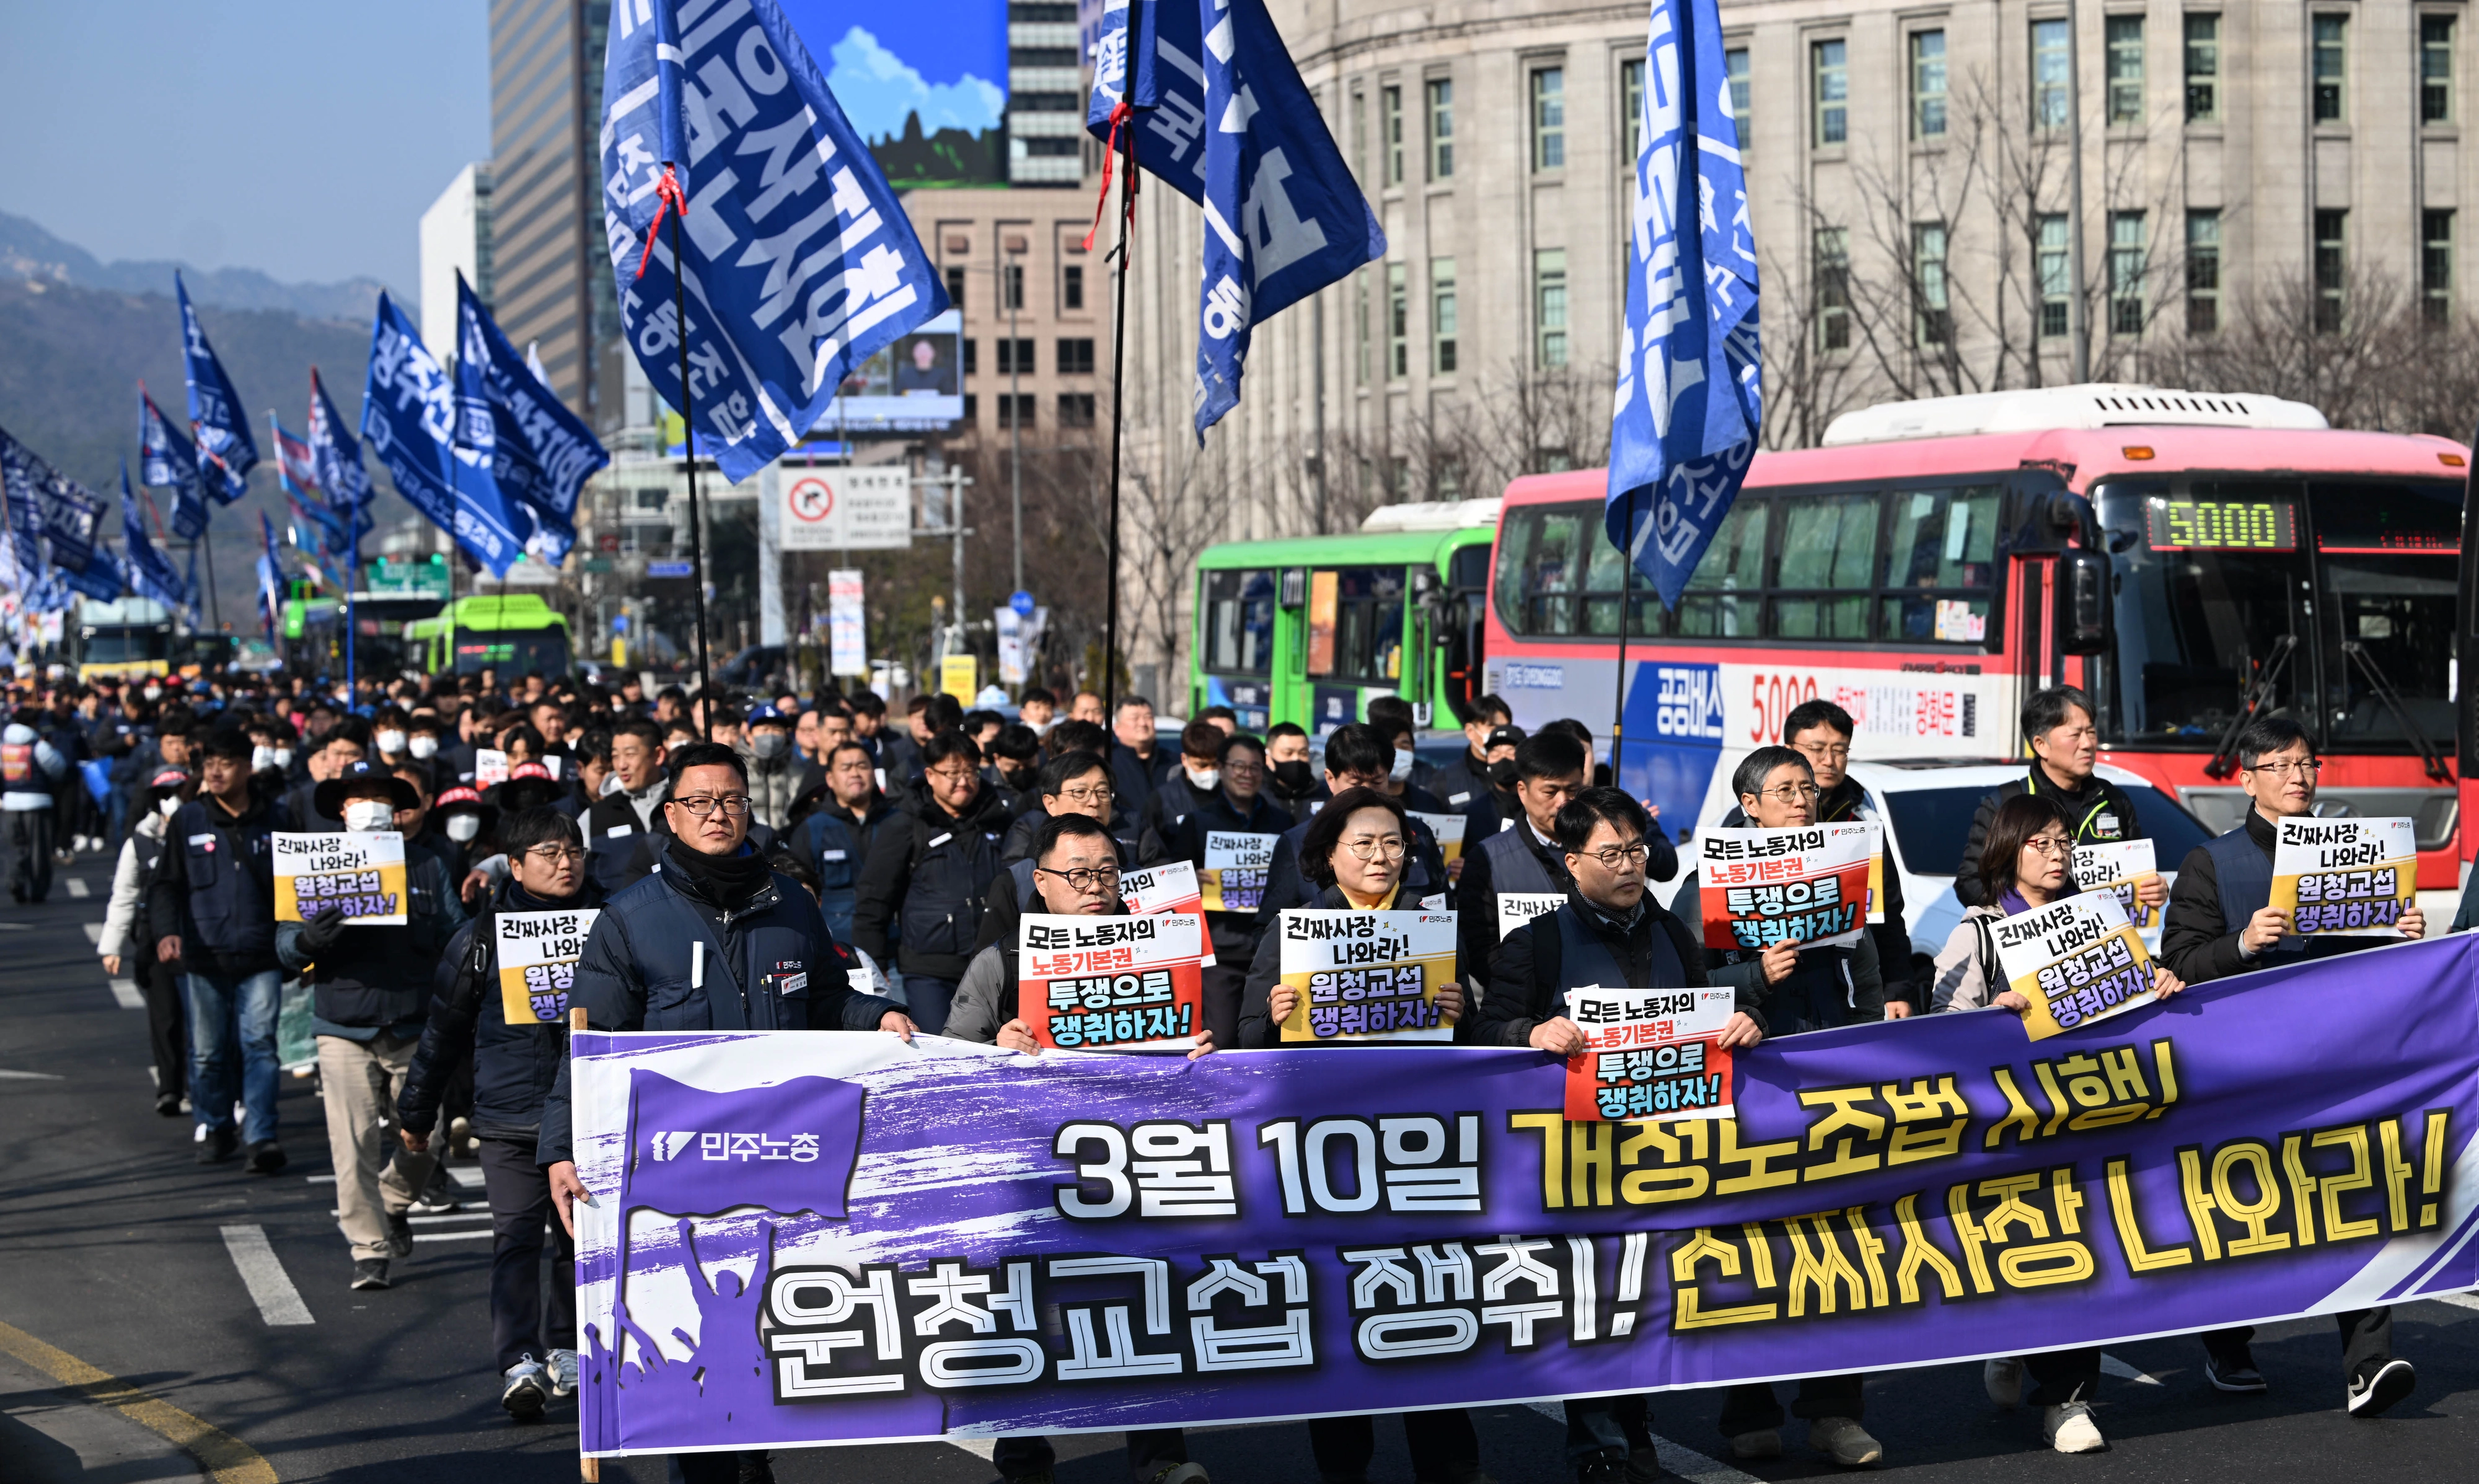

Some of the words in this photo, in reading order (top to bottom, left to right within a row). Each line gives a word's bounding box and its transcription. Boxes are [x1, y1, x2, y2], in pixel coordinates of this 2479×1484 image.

[677, 0, 917, 399] 울산지회
[2169, 502, 2276, 547] 5000
[1657, 668, 1722, 738] 공공버스
[1916, 690, 1955, 736] 광화문
[278, 838, 341, 854] 진짜사장
[1210, 836, 1262, 850] 진짜사장
[1704, 838, 1743, 860] 모든
[1748, 830, 1825, 858] 노동자의
[1841, 827, 1865, 835] 민주노총
[2283, 823, 2359, 846] 진짜사장
[310, 850, 368, 871] 나와라!
[2320, 840, 2385, 867] 나와라!
[294, 871, 380, 897] 원청교섭
[1119, 872, 1155, 898] 자의
[1167, 866, 1189, 875] 민주노총
[1710, 857, 1803, 884] 노동기본권
[2074, 861, 2121, 886] 와라!
[2298, 868, 2395, 902] 원청교섭
[1504, 899, 1564, 916] 진짜사
[1727, 876, 1839, 916] 투쟁으로
[503, 916, 578, 939] 진짜사장
[1026, 925, 1070, 949] 모든
[1075, 919, 1155, 946] 노동자의
[1287, 916, 1376, 941] 진짜사장
[1732, 904, 1856, 947] 쟁취하자!
[1997, 904, 2075, 949] 진짜사장
[2046, 913, 2108, 957] 나와라!
[542, 934, 588, 958] 나와
[1033, 947, 1132, 975] 노동기본권
[1333, 934, 1410, 964] 나와라!
[2038, 937, 2133, 998] 원청교섭
[1049, 971, 1172, 1010] 투쟁으로
[1311, 965, 1422, 1003] 원청교섭
[2050, 961, 2155, 1027] 쟁취하자!
[1310, 999, 1439, 1037] 쟁취하자!
[1577, 999, 1620, 1023] 모든
[1625, 993, 1695, 1021] 노동자의
[1050, 1004, 1190, 1045] 쟁취하자!
[1583, 1020, 1673, 1048] 노동기본권
[1598, 1043, 1703, 1082] 투쟁으로
[1598, 1075, 1719, 1117] 쟁취하자!
[1058, 1123, 1236, 1218] 3월
[1262, 1115, 1481, 1213] 10일
[1512, 1077, 1968, 1207] 개정노조법
[1985, 1041, 2178, 1148] 시행!
[701, 1132, 819, 1161] 민주노총
[770, 1255, 1314, 1398] 원청교섭
[1344, 1233, 1647, 1347] 쟁취!
[1673, 1169, 2094, 1332] 진짜사장
[2108, 1113, 2447, 1272] 나와라!
